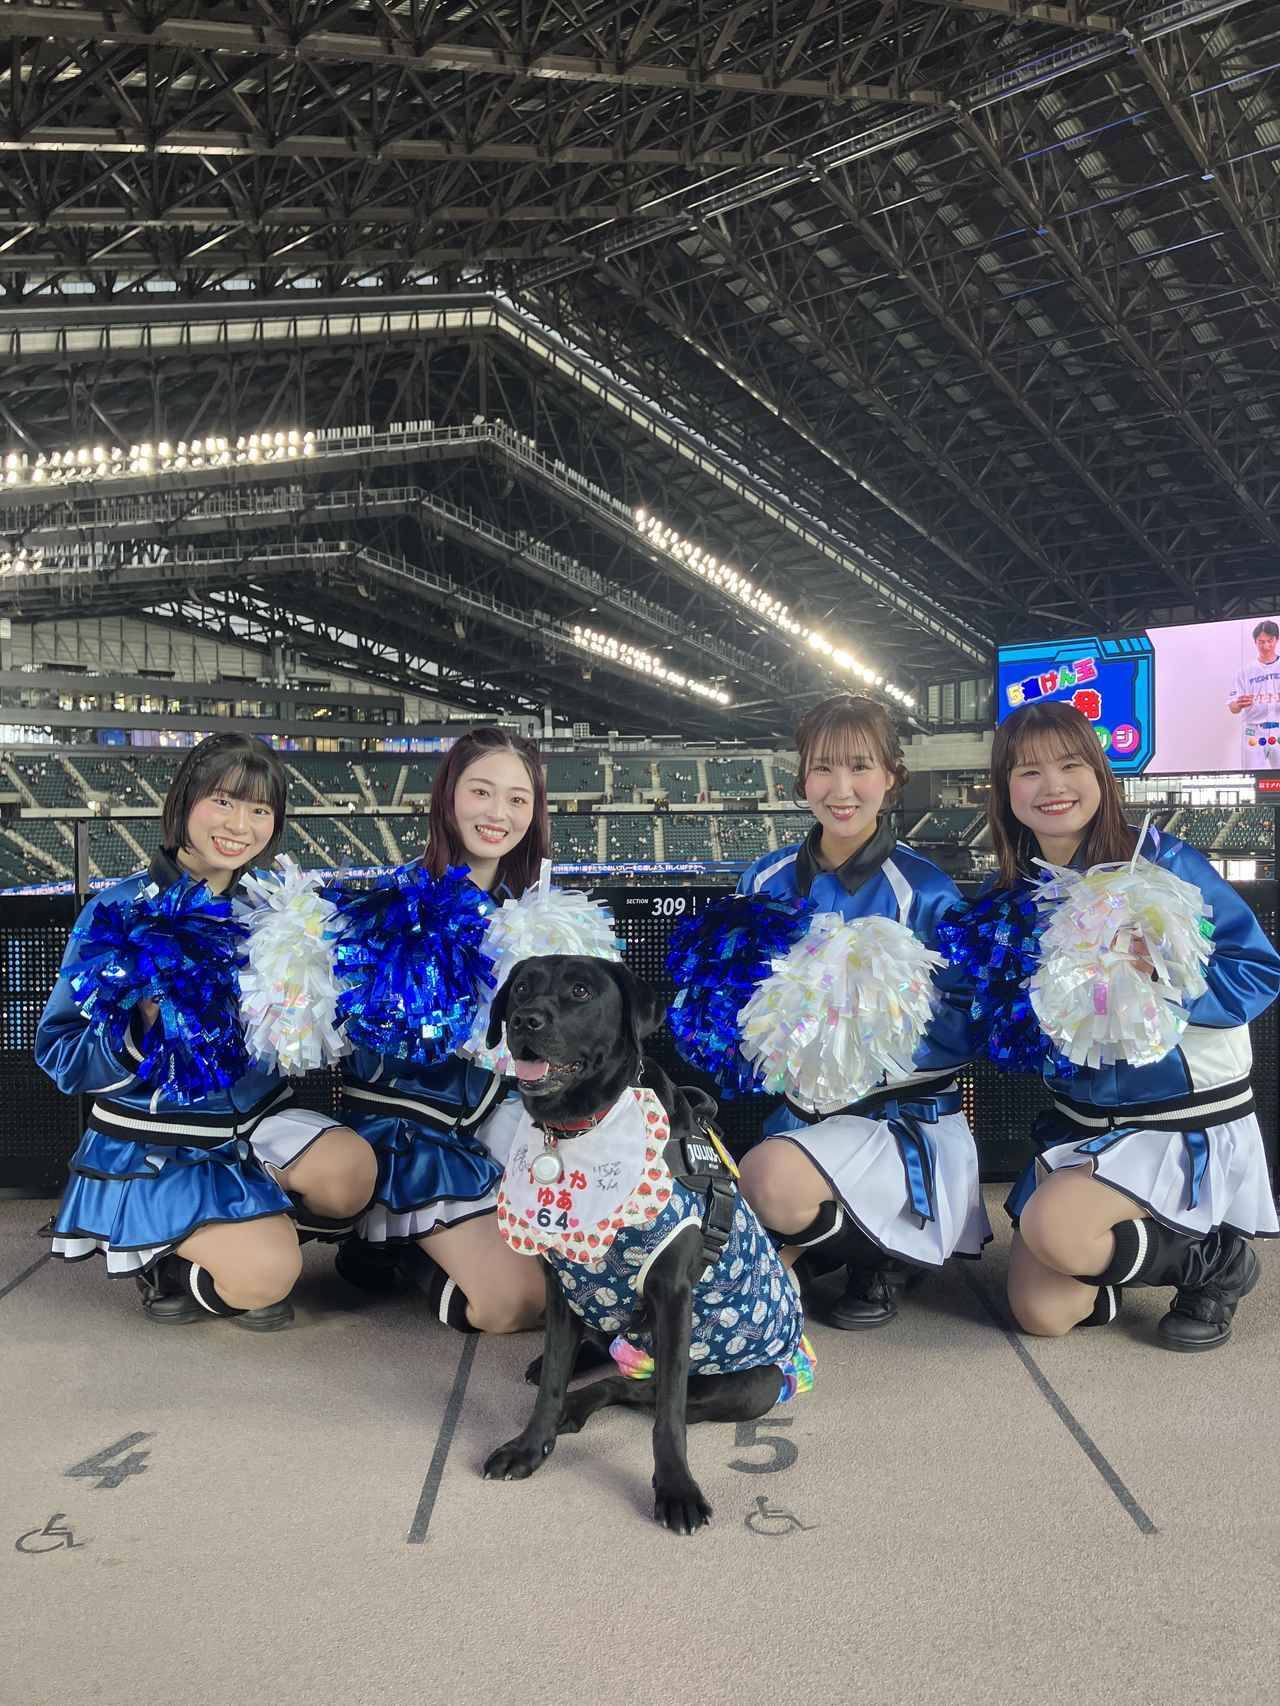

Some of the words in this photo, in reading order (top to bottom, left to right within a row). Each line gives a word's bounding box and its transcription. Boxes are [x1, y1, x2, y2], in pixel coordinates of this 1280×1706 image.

[651, 897, 686, 916] 309
[537, 1187, 572, 1211] ゆあ
[537, 1208, 568, 1231] 64
[727, 1416, 799, 1474] 5
[63, 1431, 156, 1489] 4
